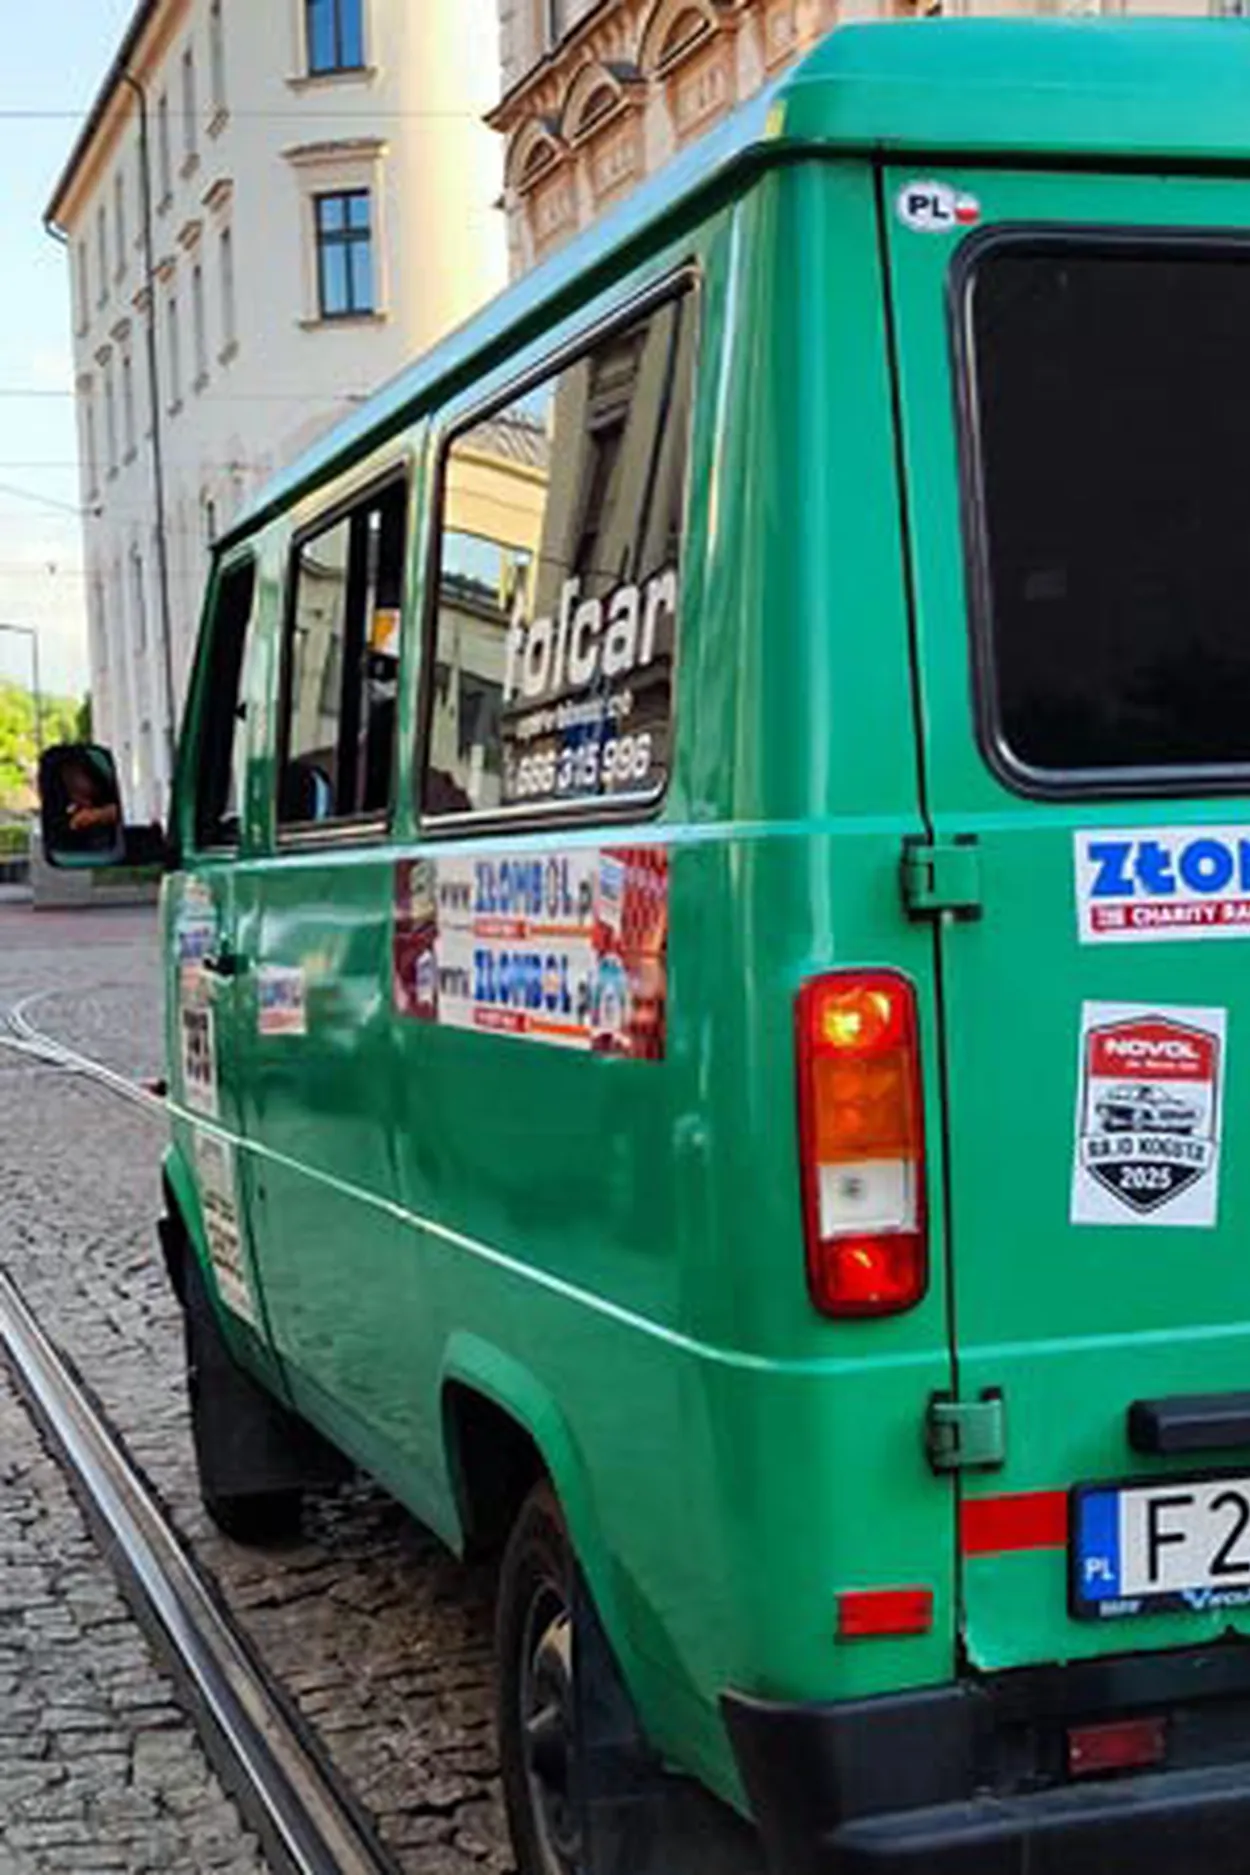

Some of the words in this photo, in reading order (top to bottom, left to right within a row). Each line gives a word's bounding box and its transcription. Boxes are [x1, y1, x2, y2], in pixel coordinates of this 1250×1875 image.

[908, 195, 949, 219] PL
[1132, 903, 1217, 926] CHARITY
[1104, 1038, 1200, 1060] NOVOL
[1119, 1166, 1172, 1190] 2025
[1083, 1556, 1116, 1583] PL
